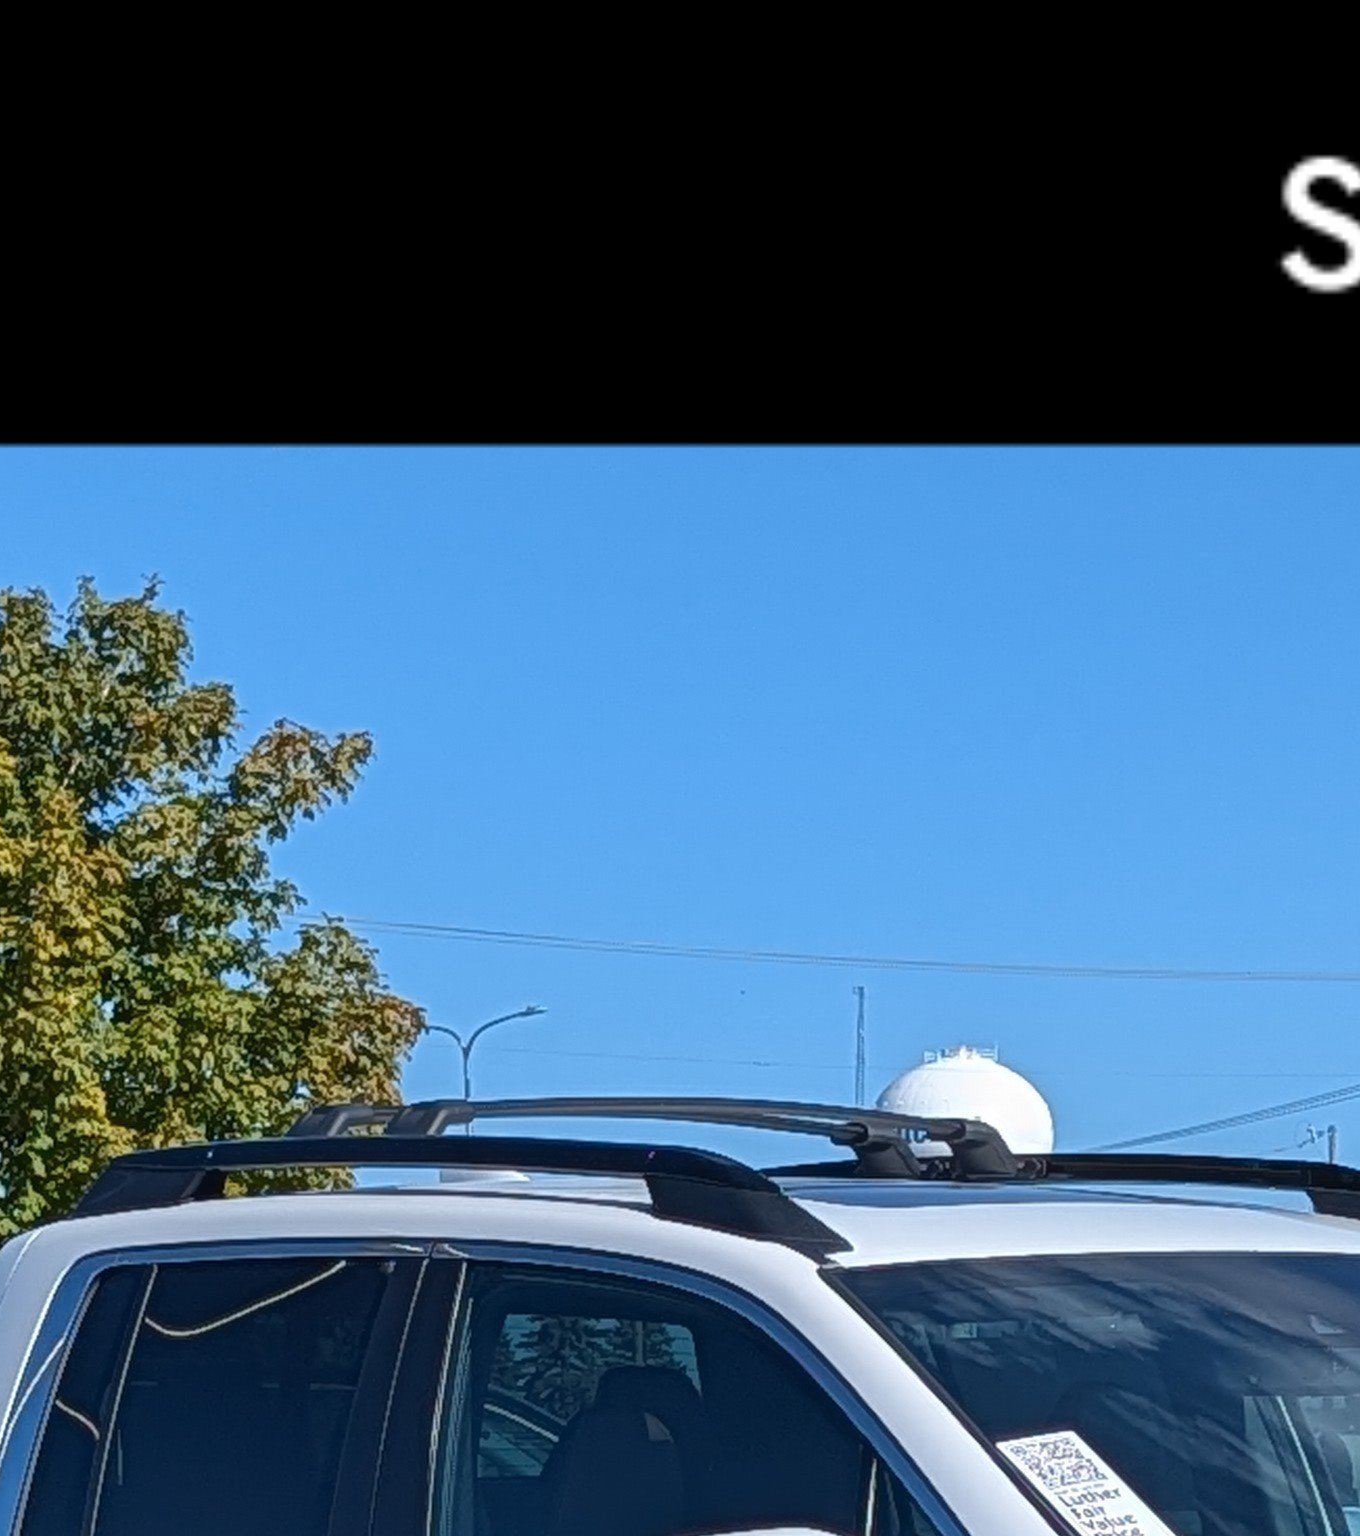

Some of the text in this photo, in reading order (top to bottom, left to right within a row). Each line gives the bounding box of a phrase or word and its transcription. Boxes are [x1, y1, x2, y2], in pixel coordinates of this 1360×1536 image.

[1058, 1488, 1121, 1507] Luther
[1070, 1505, 1106, 1520] Fair
[1081, 1514, 1138, 1531] Value
